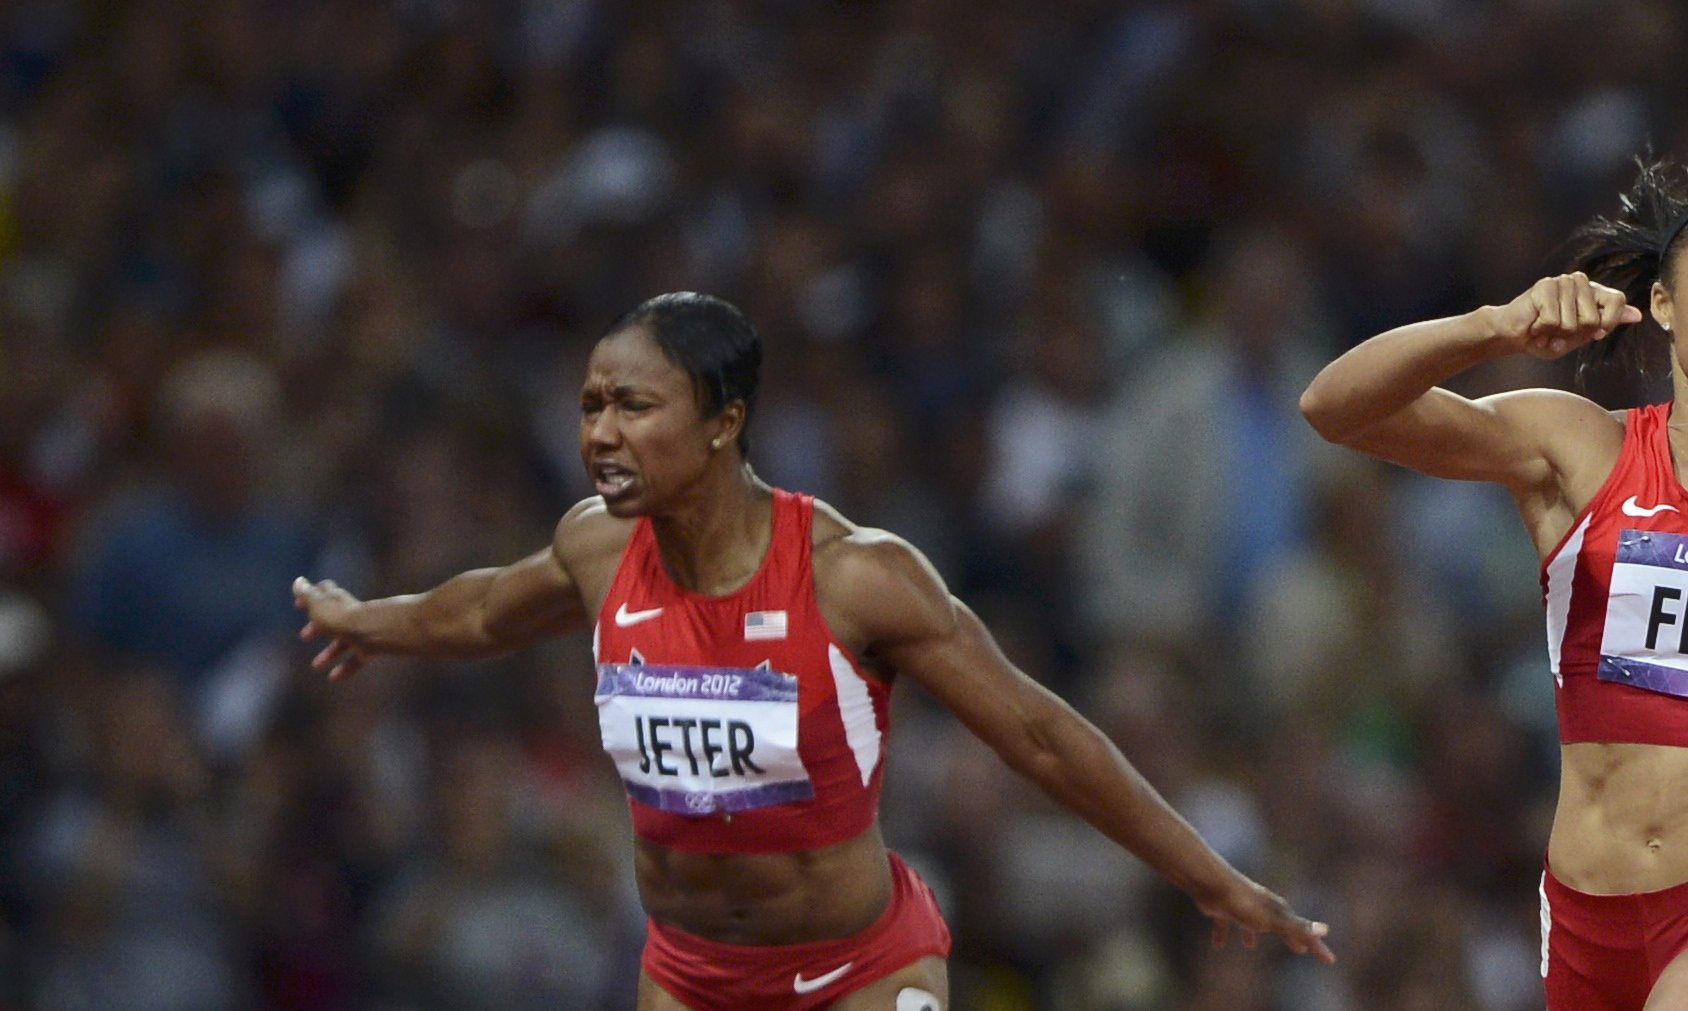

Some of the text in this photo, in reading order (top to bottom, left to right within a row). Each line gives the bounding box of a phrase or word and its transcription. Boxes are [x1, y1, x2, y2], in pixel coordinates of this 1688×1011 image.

[635, 672, 743, 695] London 2012
[634, 716, 767, 778] JETER
